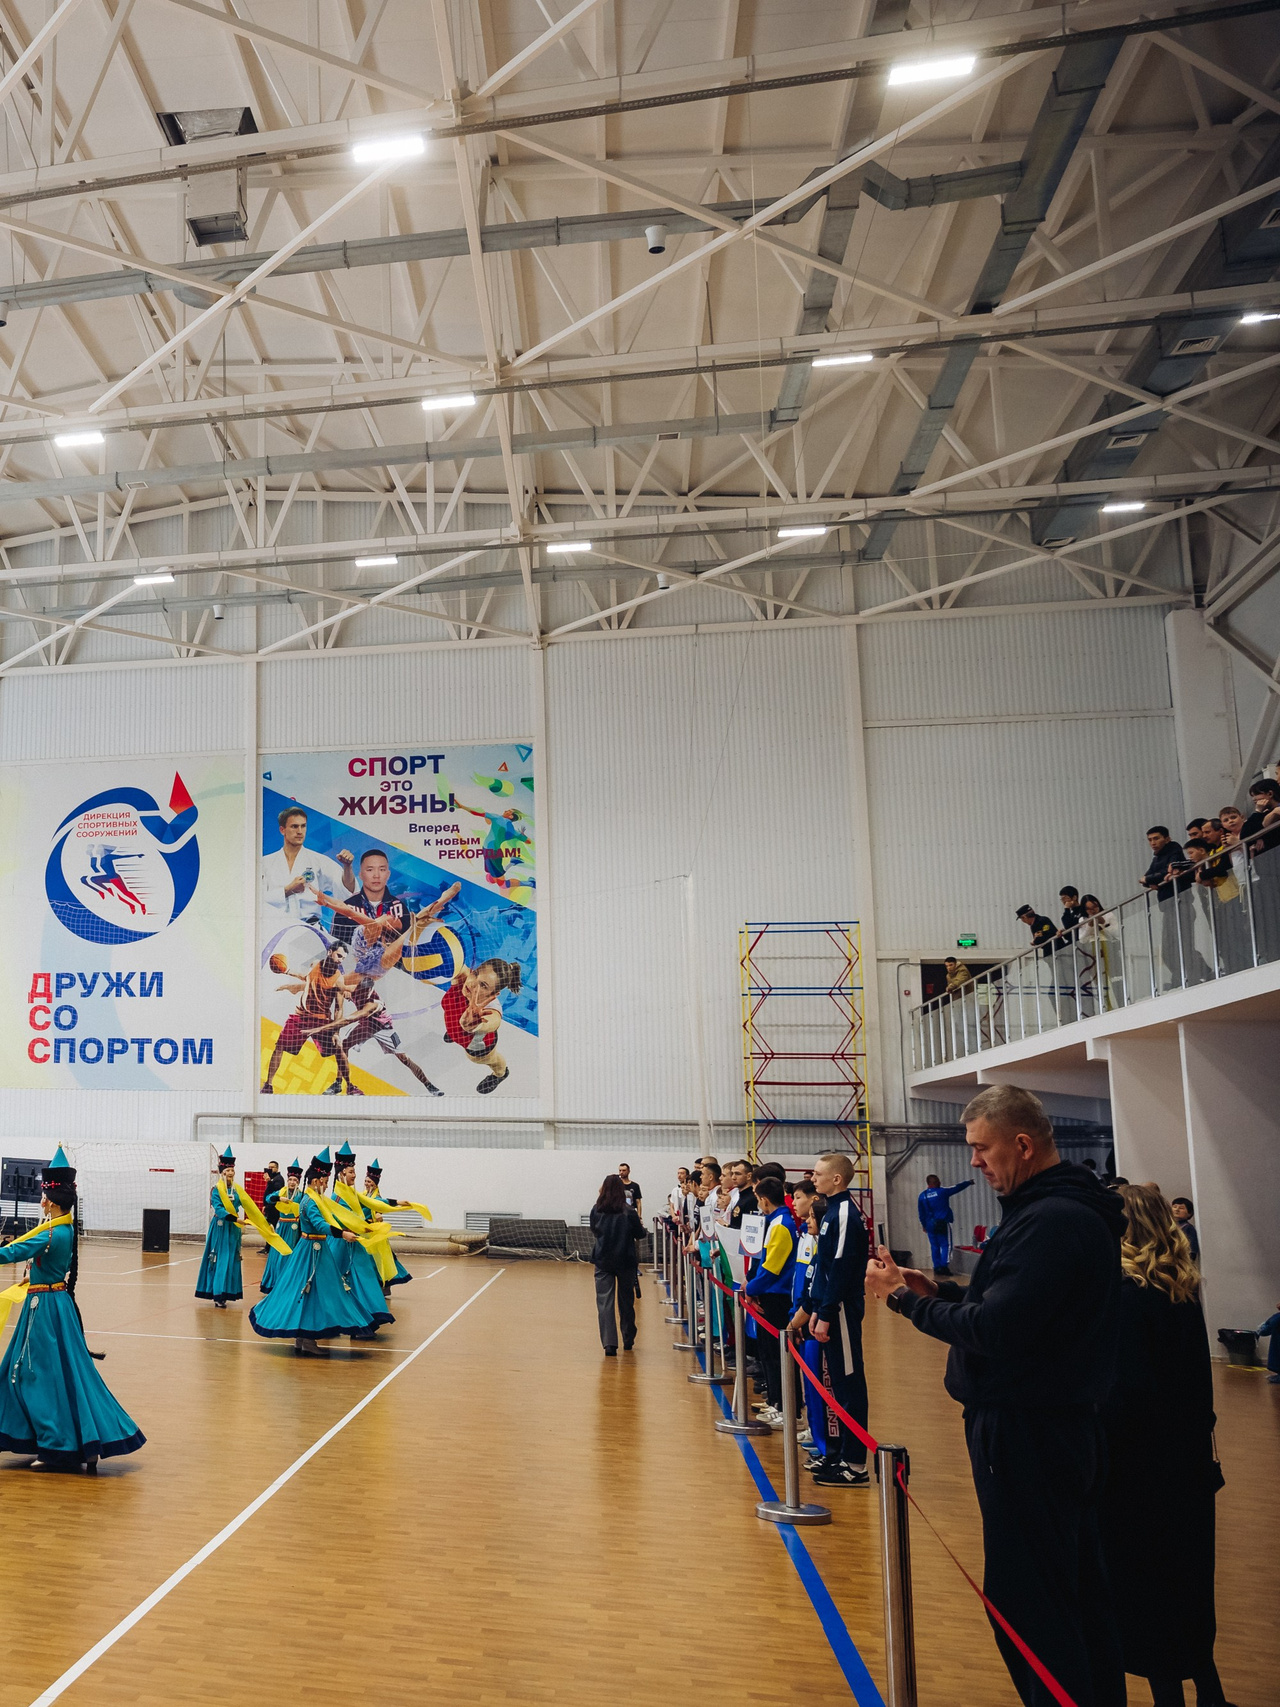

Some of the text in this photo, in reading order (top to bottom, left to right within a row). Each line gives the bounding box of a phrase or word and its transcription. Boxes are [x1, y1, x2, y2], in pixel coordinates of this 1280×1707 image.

[348, 755, 445, 777] СПОРТ
[338, 793, 455, 816] ЖИЗНЬ!
[83, 811, 131, 821] ДИРЕКЦИЯ
[77, 820, 138, 829] СПОРТИВНЫХ
[409, 823, 460, 834] Вперед
[76, 828, 138, 838] СООРУЖЕНИЙ
[435, 837, 481, 846] новым
[438, 847, 521, 860] РЕКОРДАМ!
[27, 971, 163, 1003] ДРУЖИ
[29, 1005, 78, 1031] СО
[27, 1037, 213, 1064] СПОРТОМ
